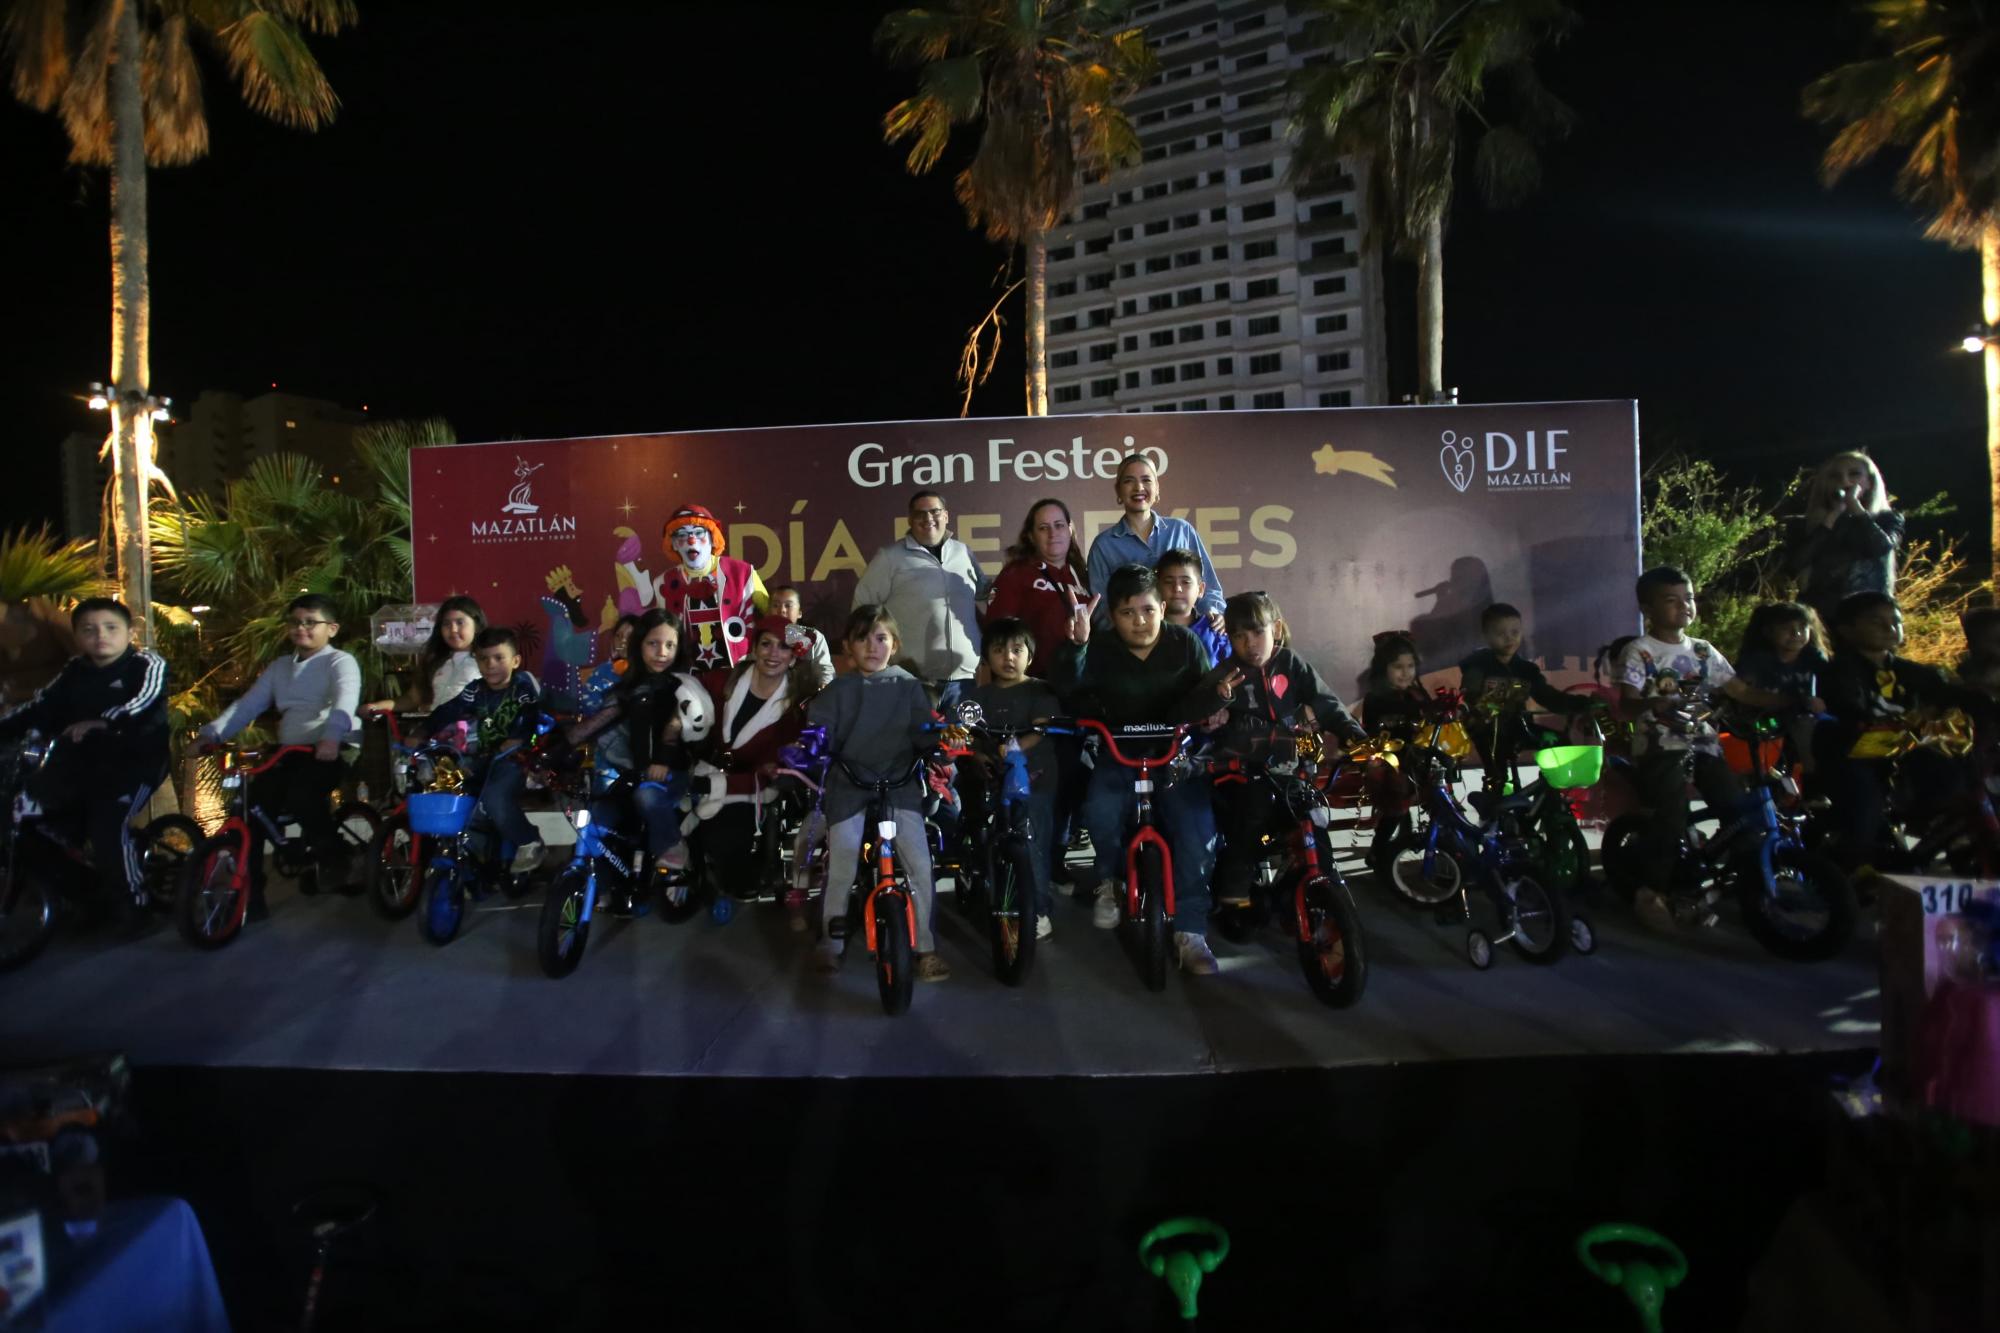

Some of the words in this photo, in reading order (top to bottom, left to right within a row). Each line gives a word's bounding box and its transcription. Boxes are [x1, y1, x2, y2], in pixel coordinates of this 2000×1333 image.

[848, 443, 974, 487] Gran
[988, 436, 1169, 483] Festeo
[1485, 430, 1569, 472] DIF
[1487, 471, 1571, 486] MAZATLÁN
[471, 514, 577, 537] MAZATLÁN
[728, 499, 868, 583] DÍA
[1123, 722, 1166, 732] macilux
[1922, 884, 1973, 914] 310
